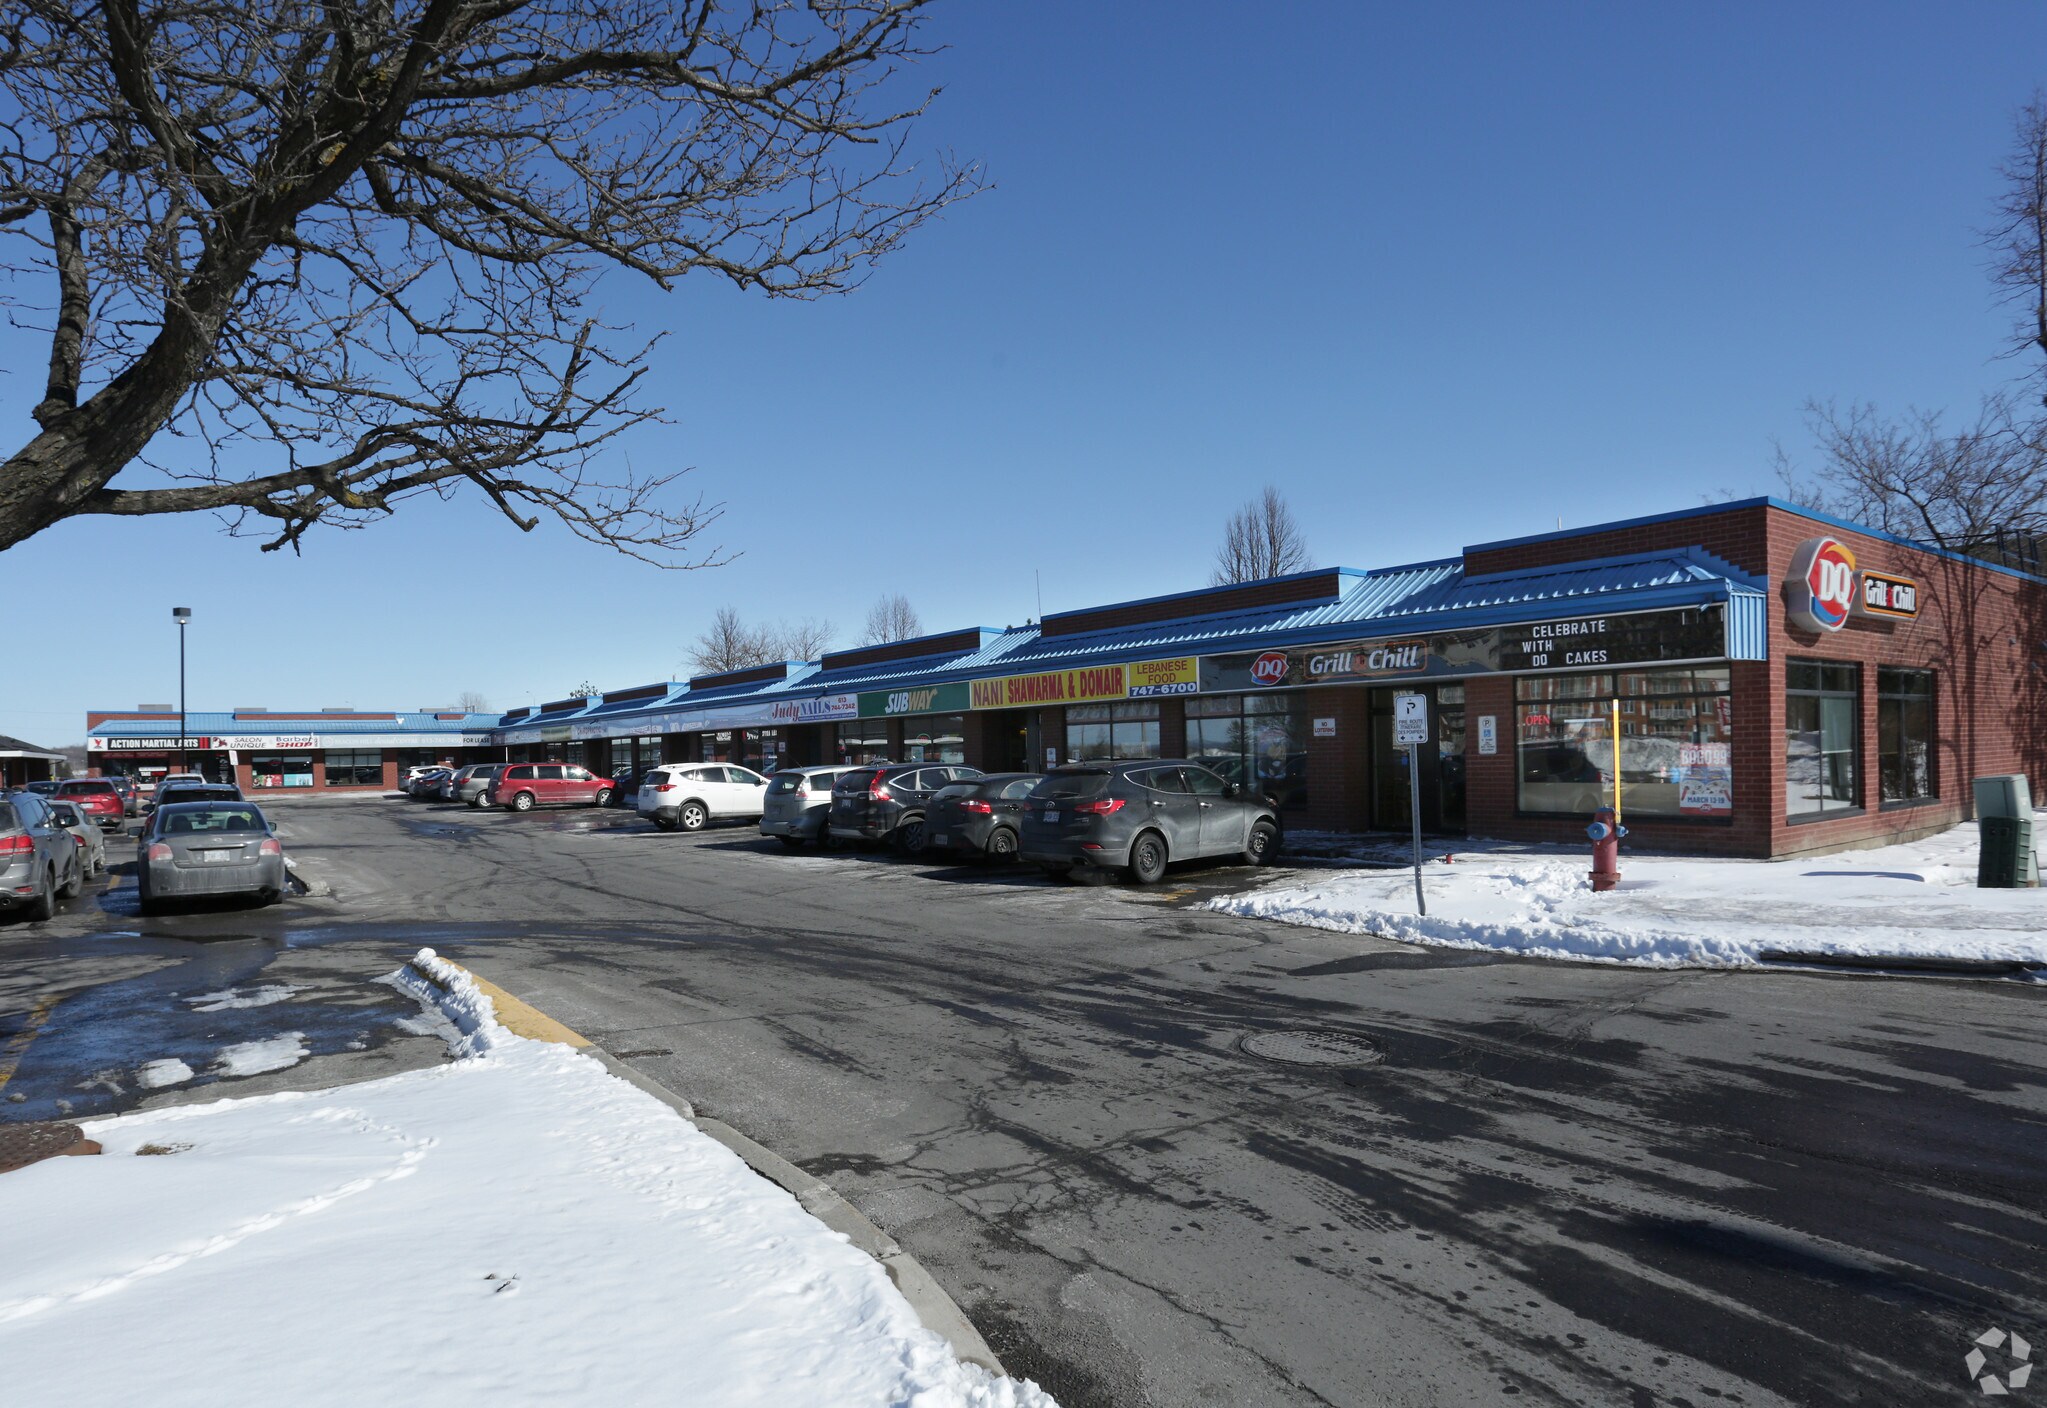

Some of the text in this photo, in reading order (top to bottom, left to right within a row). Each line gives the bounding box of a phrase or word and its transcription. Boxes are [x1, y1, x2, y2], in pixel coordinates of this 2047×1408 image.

[1818, 558, 1851, 610] DQ
[1865, 578, 1915, 611] Grill Chill
[1533, 620, 1606, 638] CELEBRATE
[1522, 640, 1553, 653] WITH
[1310, 645, 1418, 675] Grill Chill
[1566, 650, 1607, 664] CAKES
[1137, 660, 1188, 674] LEBANESE
[1257, 660, 1283, 677] DQ
[973, 667, 1123, 707] NANI SHAWARMA & DONAIR
[1148, 673, 1176, 684] FOOD
[1131, 682, 1196, 696] 747-6700
[884, 688, 938, 714] SUBWAY
[772, 702, 799, 721] Judy
[801, 701, 830, 715] NAILS
[1525, 714, 1550, 726] OPEN
[110, 738, 199, 749] ACTION MARTIAL ARTS
